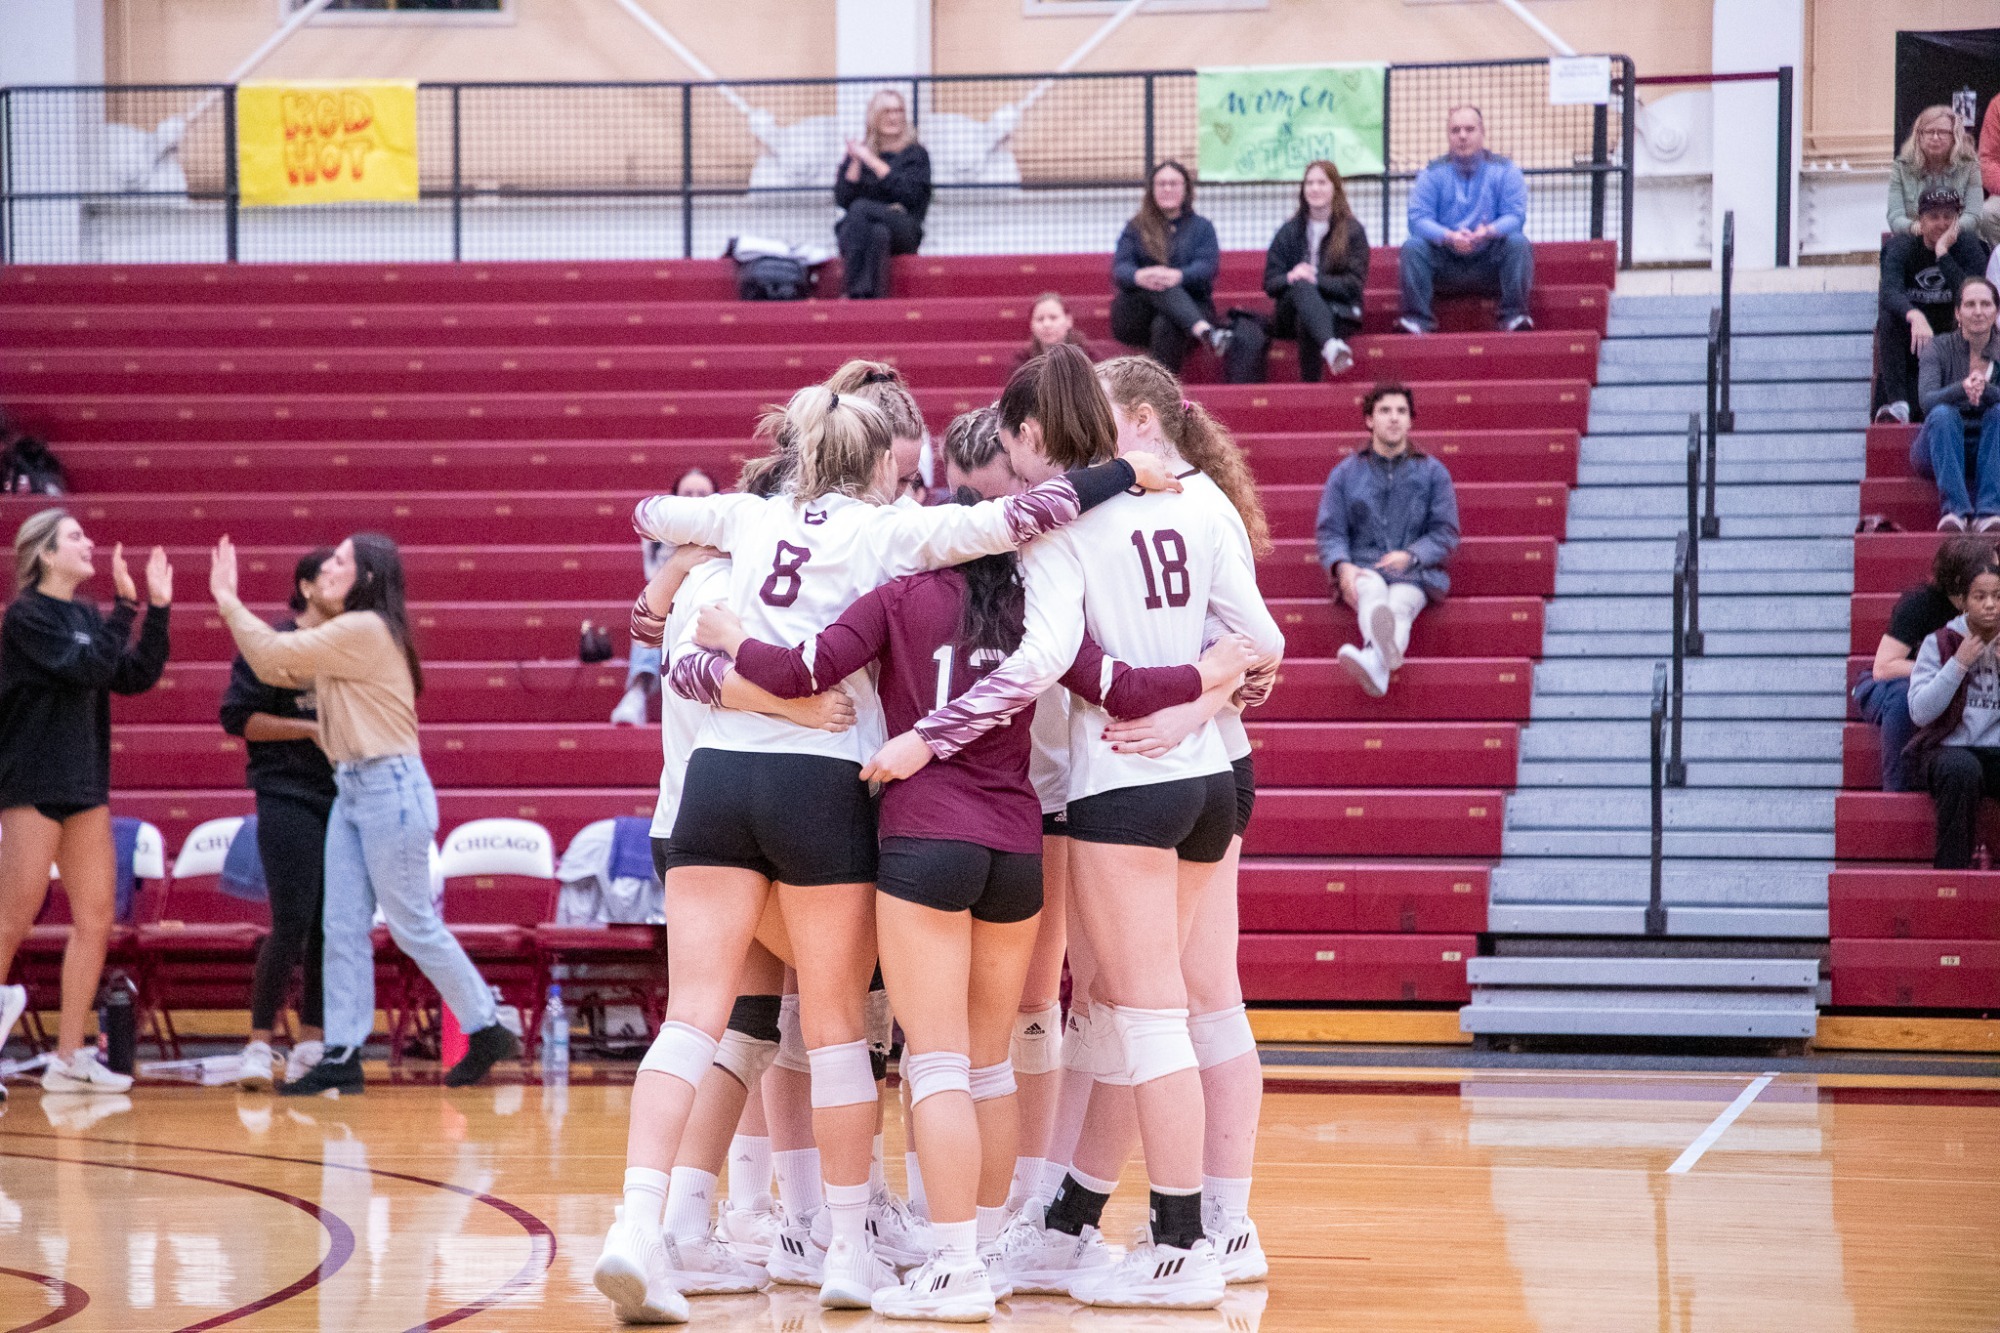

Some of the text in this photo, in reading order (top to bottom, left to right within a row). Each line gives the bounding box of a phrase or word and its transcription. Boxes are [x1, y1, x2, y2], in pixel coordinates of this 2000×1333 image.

[1236, 132, 1335, 175] STEM
[759, 539, 812, 608] 8
[1131, 528, 1190, 610] 18
[454, 836, 540, 853] CHICAGO
